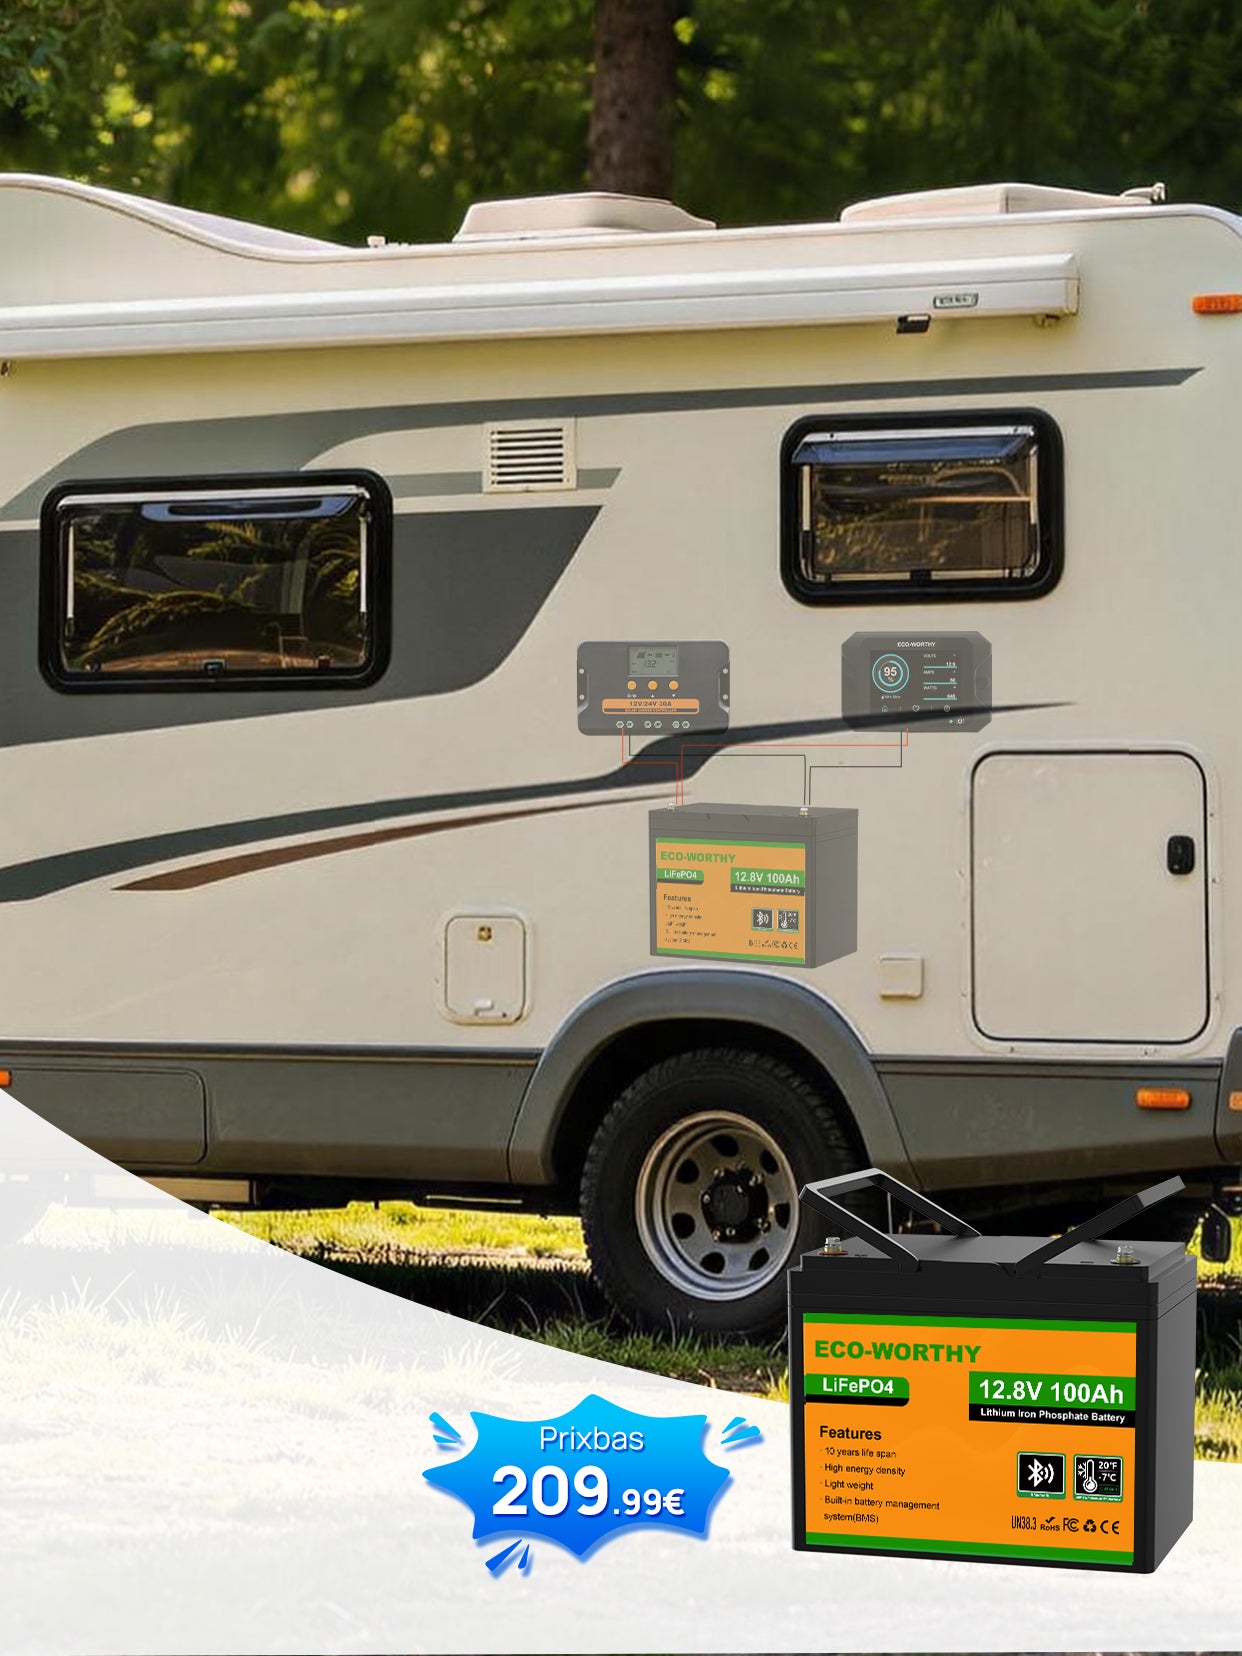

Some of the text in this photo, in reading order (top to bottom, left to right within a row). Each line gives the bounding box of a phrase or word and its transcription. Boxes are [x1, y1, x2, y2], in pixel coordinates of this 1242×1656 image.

[883, 666, 897, 677] 95
[660, 851, 736, 864] ECO-WORTHY
[664, 869, 697, 879] LiFePO4
[735, 871, 800, 885] 12.8V 100Ah
[663, 893, 692, 902] Features
[815, 1339, 982, 1363] ECO-WORTHY
[822, 1377, 894, 1395] LiFePO4
[979, 1379, 1124, 1405] 12.8V 100Ah
[980, 1407, 1126, 1425] Lithium Iron Phosphate Battery
[819, 1425, 882, 1441] Features
[825, 1447, 897, 1459] 10 years life span
[824, 1463, 906, 1477] High energy density
[824, 1479, 874, 1491] Light weight
[824, 1495, 940, 1510] Built-in battery management
[823, 1512, 879, 1525] system(BMS)
[1011, 1515, 1037, 1530] UN38.3
[1040, 1523, 1060, 1532] RoHS
